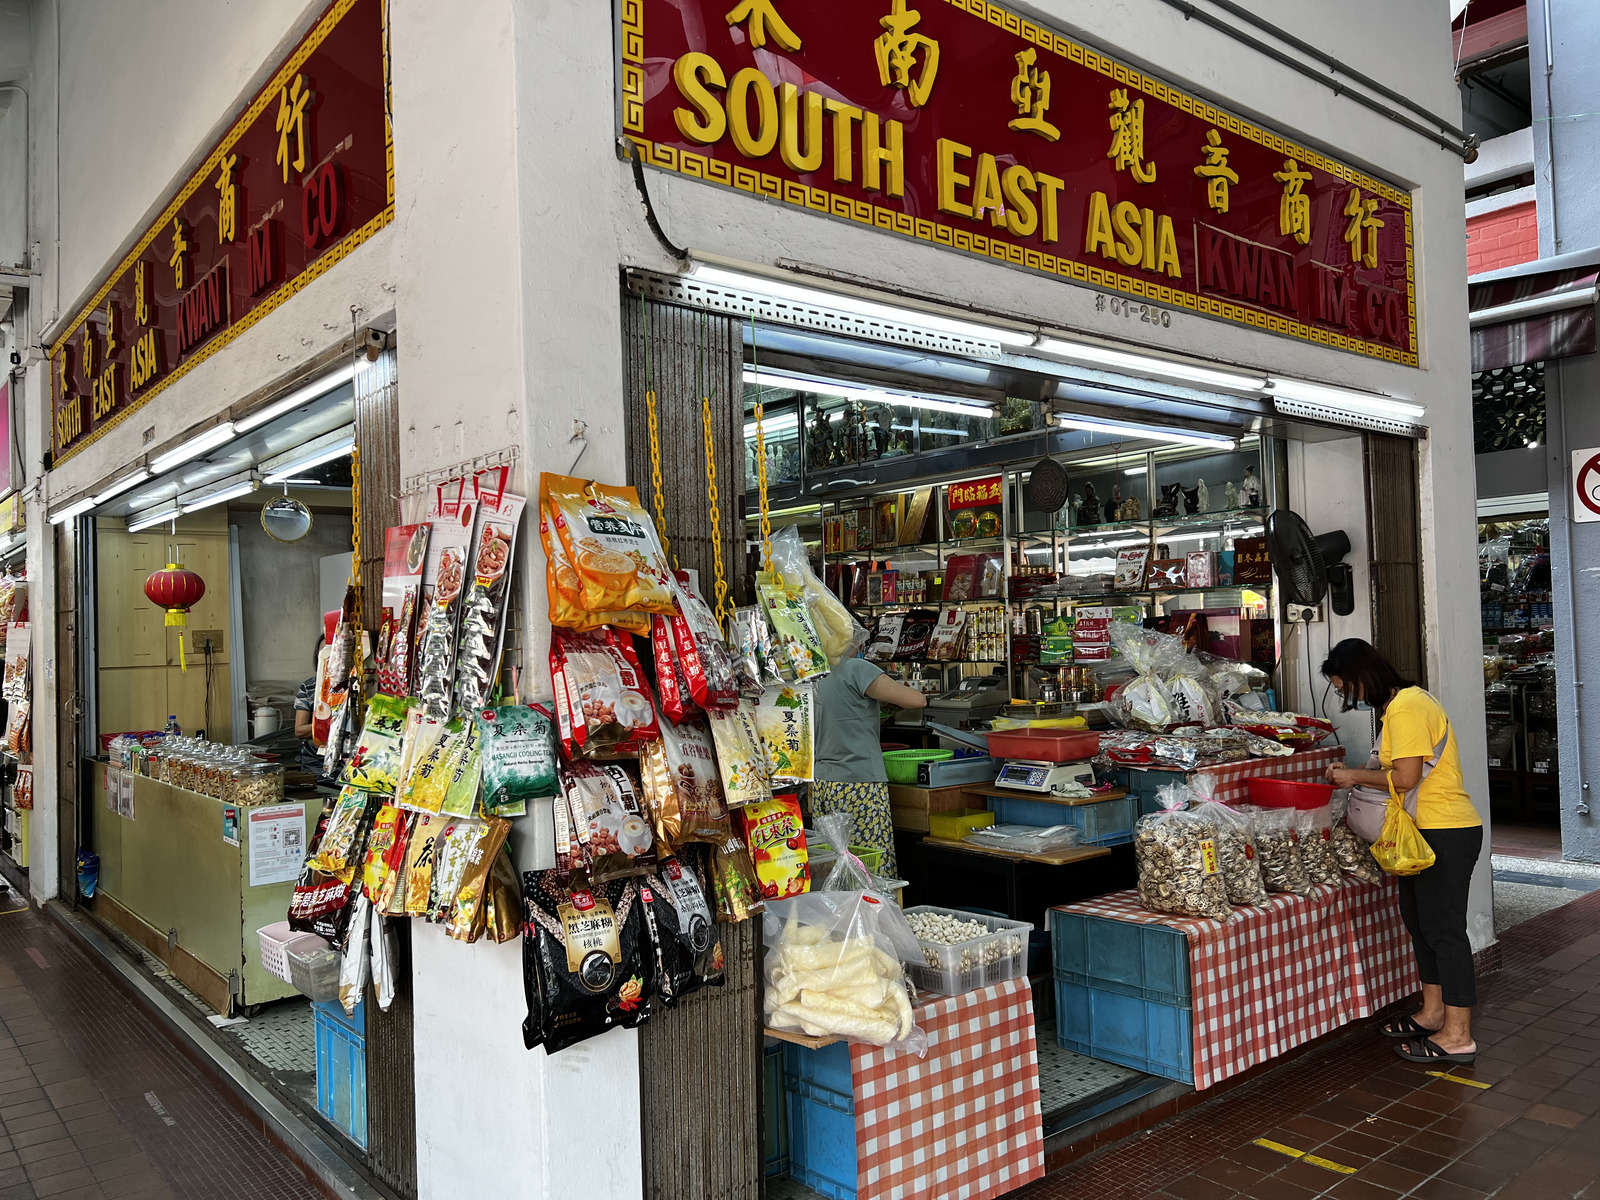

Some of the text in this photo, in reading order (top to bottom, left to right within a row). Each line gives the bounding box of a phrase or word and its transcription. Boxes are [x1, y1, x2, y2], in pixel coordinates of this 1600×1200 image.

[673, 51, 1401, 341] SOUTH EAST ASIA KWAN IM CO
[57, 162, 342, 449] SOUTH EAST ASIA KWAN IM CO
[1095, 294, 1172, 329] #01-250
[492, 720, 546, 738] 夏桑菊
[782, 710, 799, 752] 夏桑菊
[419, 733, 450, 779] 夏桑菊
[518, 750, 543, 758] COOLING
[607, 766, 637, 811] 杏仁霜
[413, 836, 435, 869] 茶
[568, 917, 613, 935] 黑芝麻糊
[572, 928, 611, 940] sesame paste
[583, 936, 603, 949] 核桃
